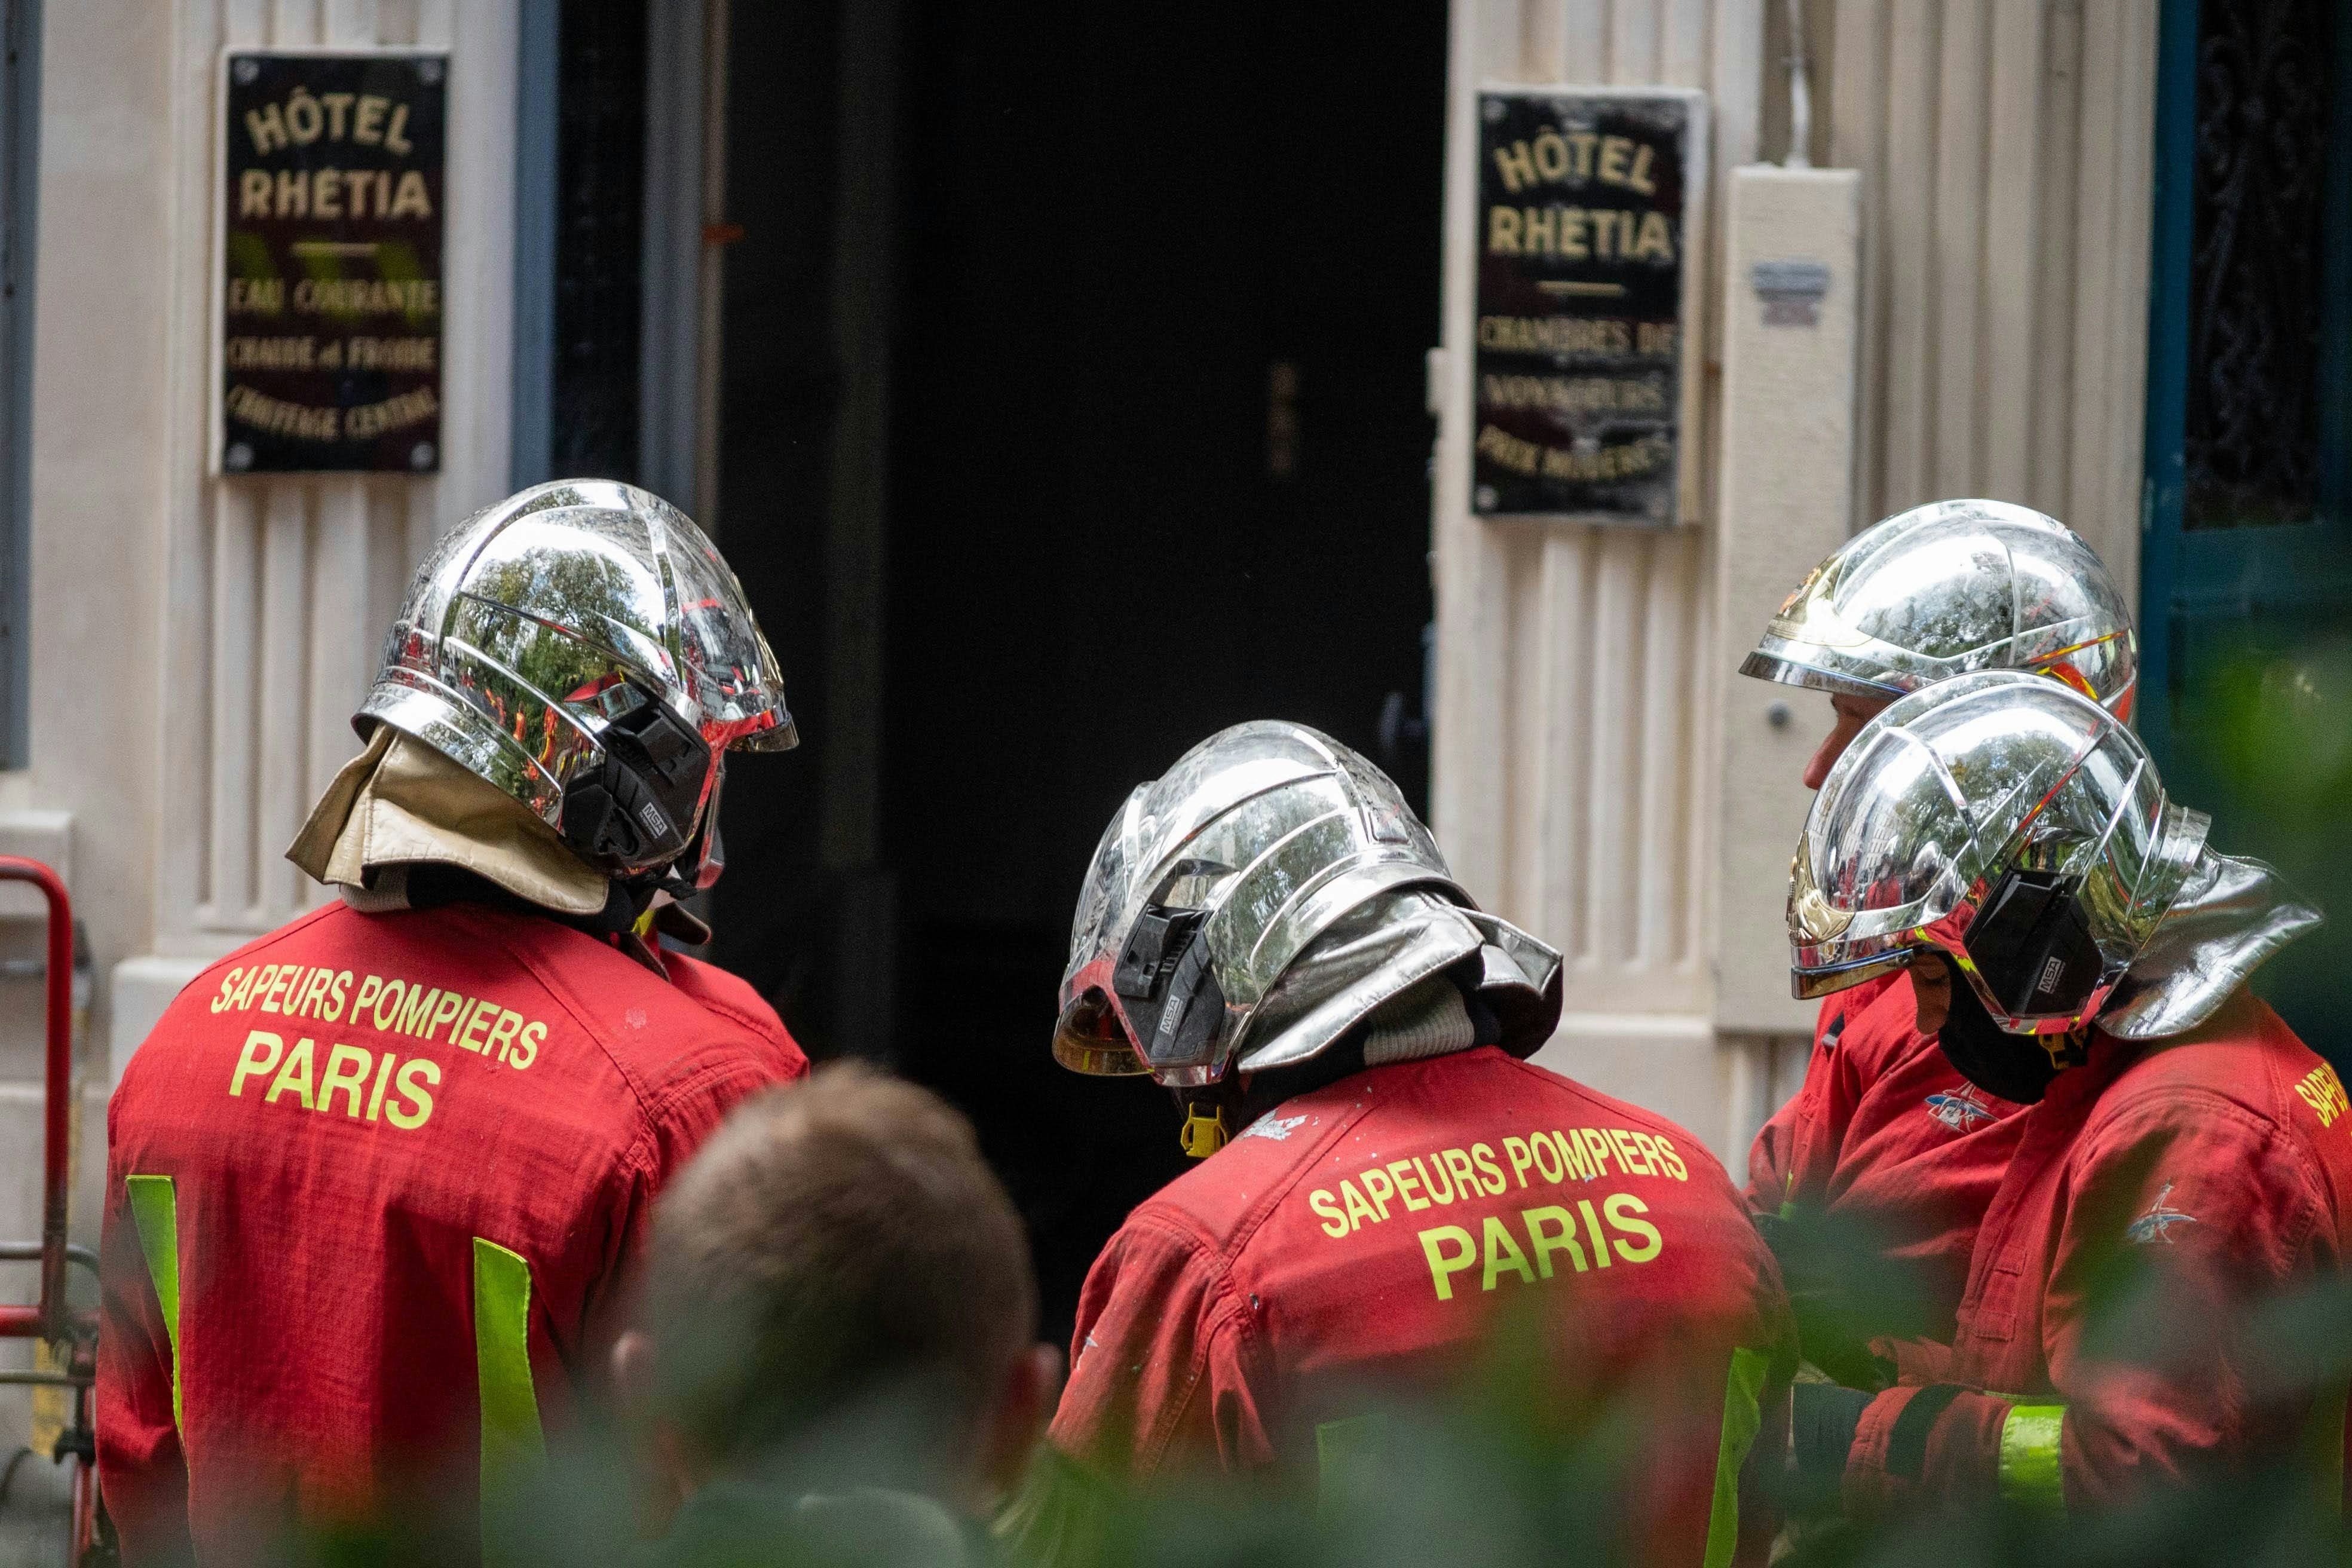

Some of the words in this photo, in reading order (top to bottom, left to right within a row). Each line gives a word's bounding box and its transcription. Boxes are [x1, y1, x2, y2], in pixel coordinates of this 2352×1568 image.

[244, 85, 413, 157] HÔTEL
[1494, 125, 1656, 197] HÔTEL
[642, 804, 666, 835] MSA
[2039, 958, 2060, 992] MSA
[210, 964, 353, 1022] SAPEURS
[350, 975, 547, 1070] POMPIERS
[1160, 997, 1179, 1033] MSA
[229, 1030, 441, 1129] PARIS
[1309, 1143, 1507, 1238] SAPEURS
[1502, 1128, 1688, 1189] POMPIERS
[1418, 1193, 1662, 1300] PARIS
